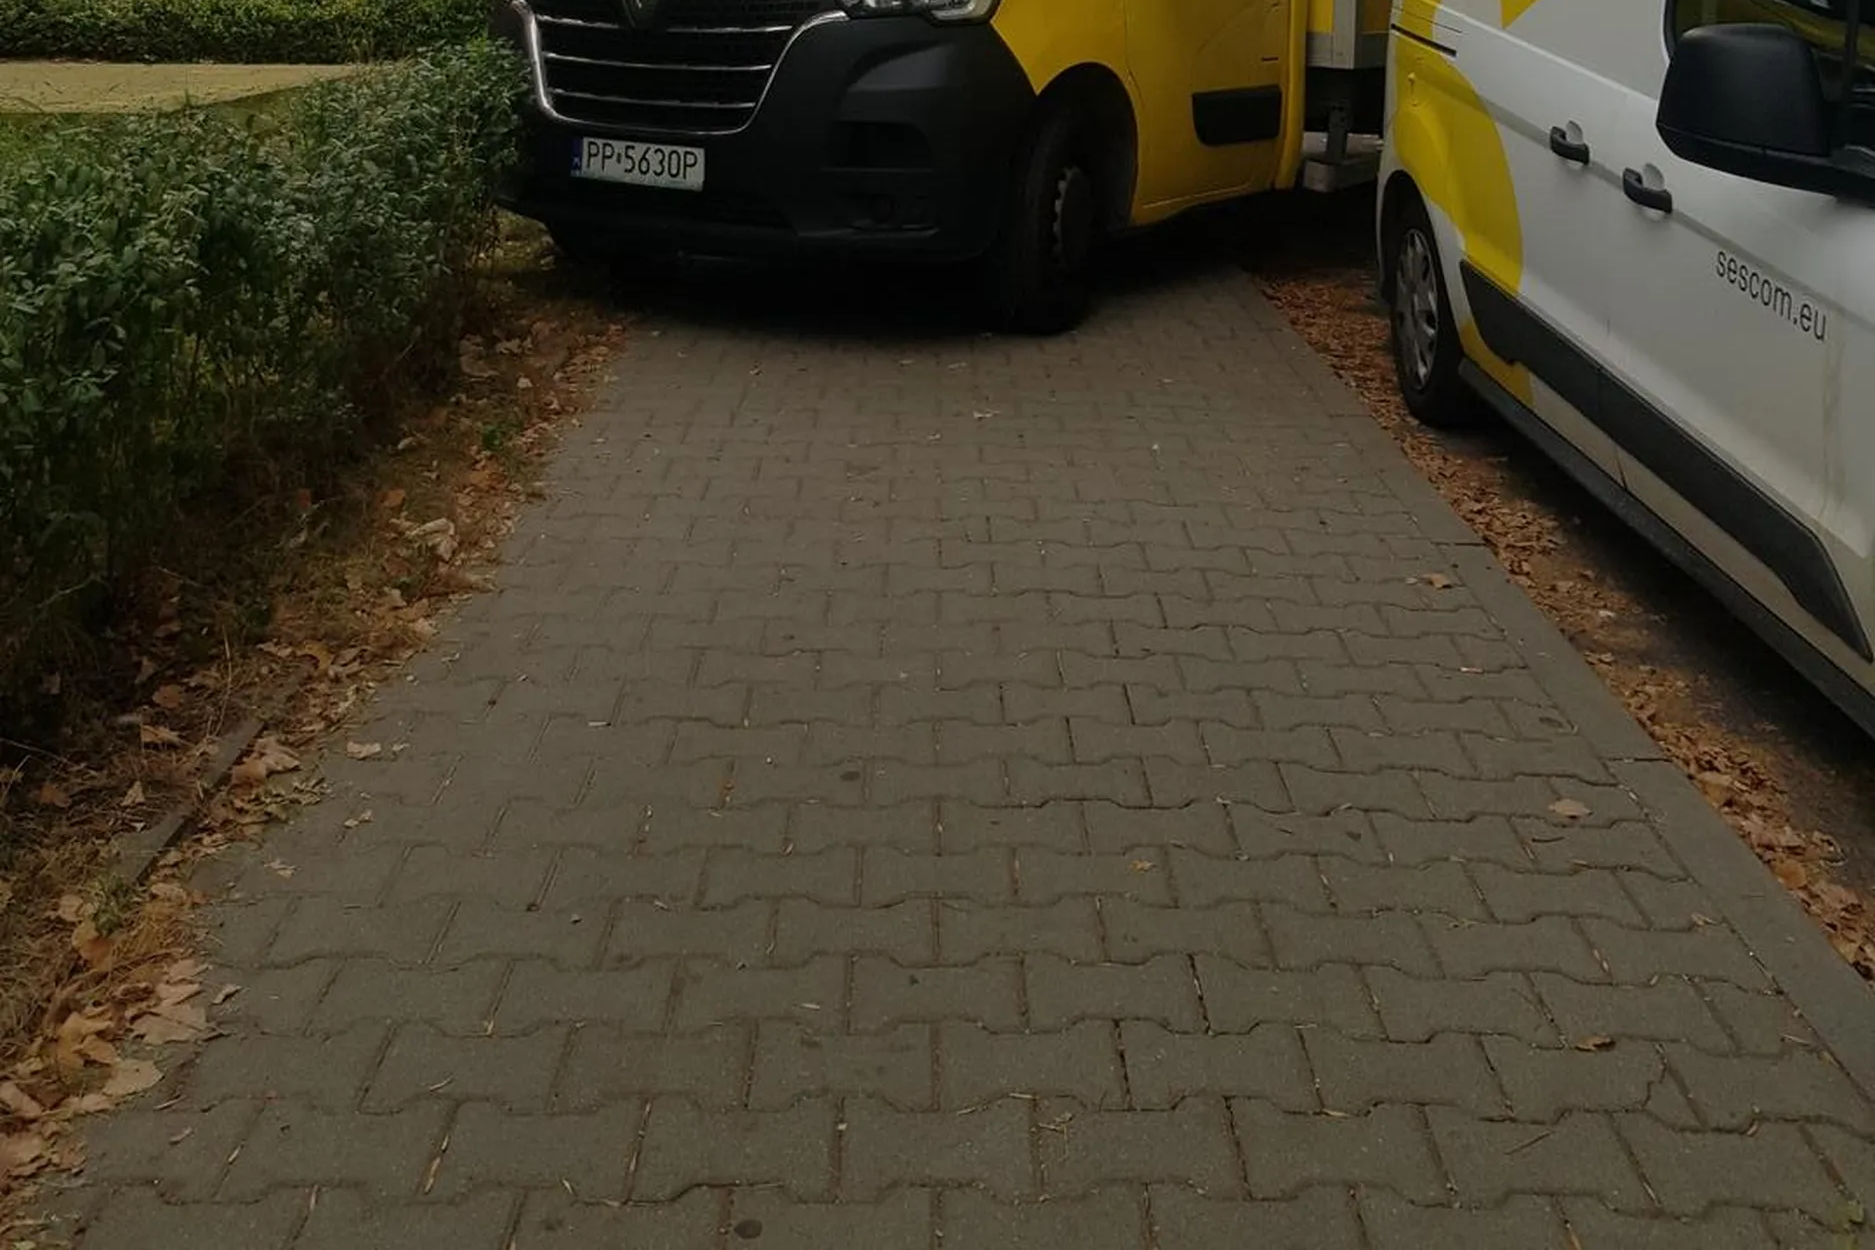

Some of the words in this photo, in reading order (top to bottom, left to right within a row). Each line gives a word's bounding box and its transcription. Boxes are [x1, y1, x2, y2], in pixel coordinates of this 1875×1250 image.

[586, 141, 615, 170] PP
[624, 145, 698, 181] 5630P
[1715, 251, 1827, 342] sescom.eu
